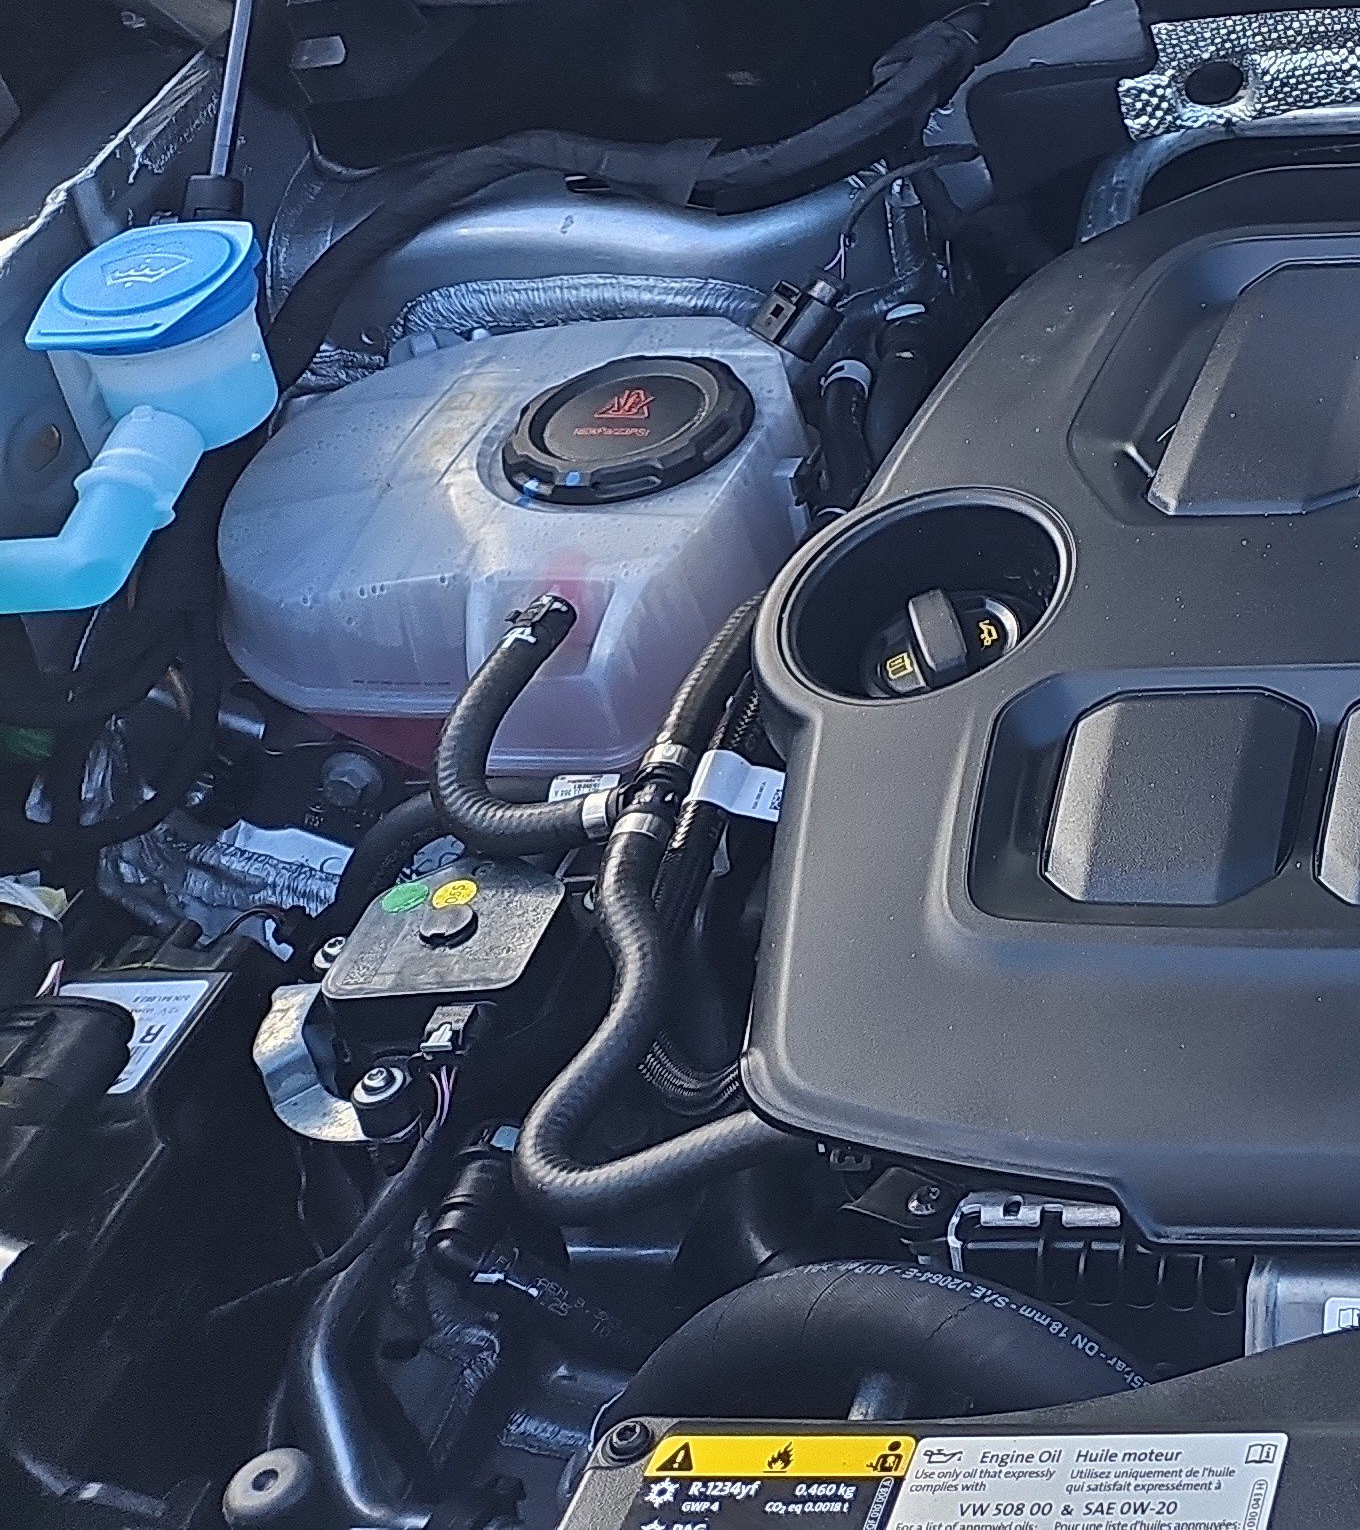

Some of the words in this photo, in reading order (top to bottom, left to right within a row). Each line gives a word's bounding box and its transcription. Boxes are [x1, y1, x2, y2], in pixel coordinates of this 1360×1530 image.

[980, 1451, 1036, 1467] Engine
[1038, 1449, 1062, 1463] Oil
[1076, 1449, 1118, 1463] Huile
[1121, 1450, 1183, 1463] moteur
[915, 1469, 935, 1479] Use
[937, 1469, 961, 1482] only
[963, 1469, 977, 1479] oil
[979, 1469, 1001, 1479] that
[1004, 1469, 1056, 1481] expressly
[1070, 1469, 1111, 1480] Utilisez
[1114, 1469, 1183, 1481] uniquement
[1185, 1467, 1200, 1478] de
[687, 1480, 762, 1498] R-1234yf
[795, 1483, 835, 1497] 0.460
[837, 1483, 856, 1499] kg
[910, 1482, 959, 1494] complies
[961, 1481, 986, 1492] with
[1065, 1482, 1084, 1495] qui
[1086, 1481, 1131, 1492] satisfait
[1134, 1480, 1212, 1493] expressément
[1214, 1480, 1222, 1490] à
[681, 1502, 710, 1513] GWP
[959, 1503, 990, 1517] VW
[992, 1503, 1026, 1517] 508
[1029, 1503, 1052, 1517] 00
[1061, 1504, 1074, 1516] &
[1083, 1502, 1116, 1516] SAE
[1120, 1501, 1178, 1515] 0W-20
